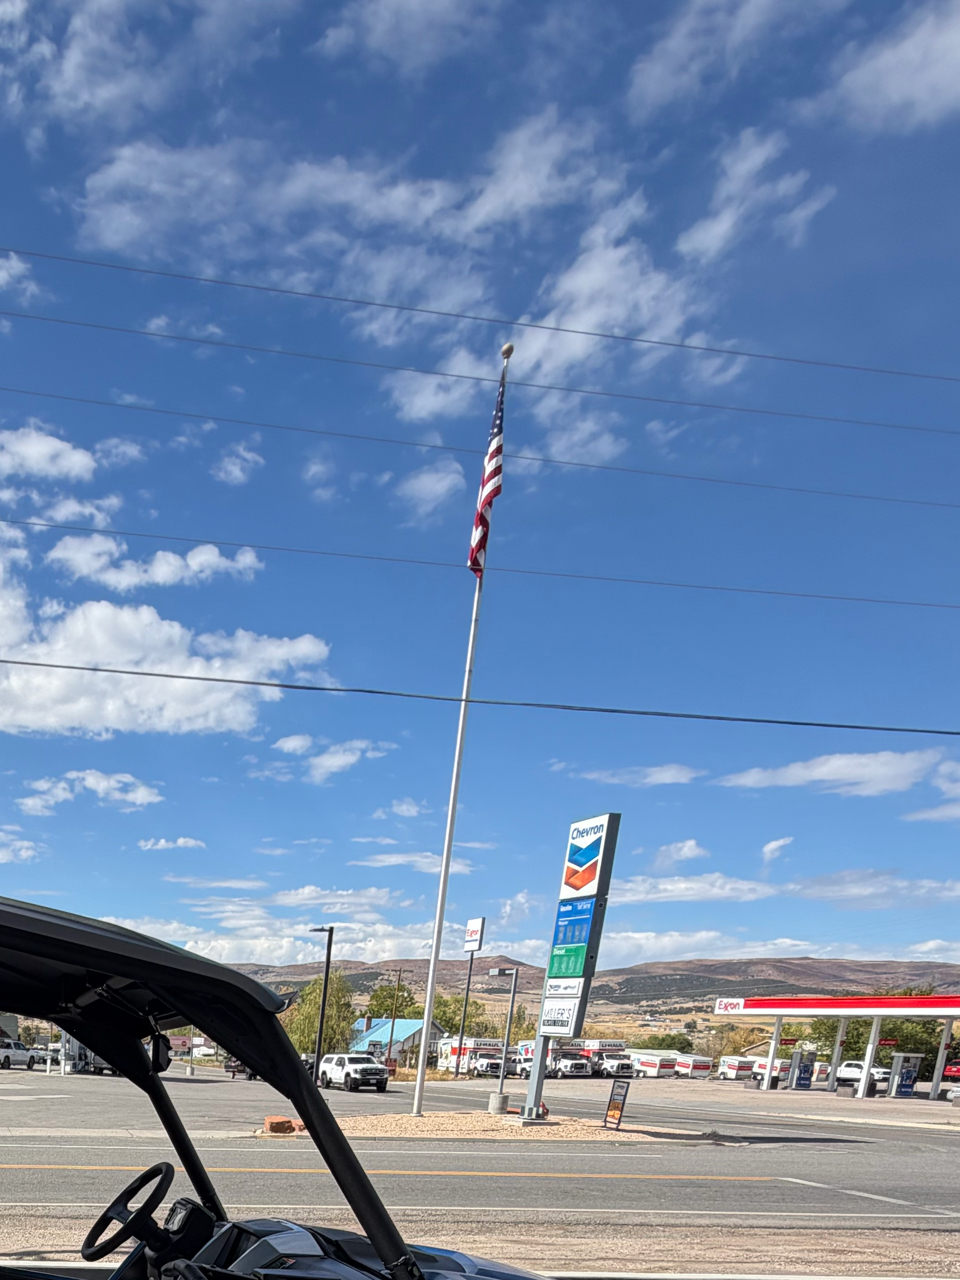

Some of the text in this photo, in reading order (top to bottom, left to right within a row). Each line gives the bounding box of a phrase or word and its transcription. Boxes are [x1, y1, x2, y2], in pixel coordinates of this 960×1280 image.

[571, 823, 605, 840] Chevron
[718, 1000, 740, 1012] Exxon
[543, 1008, 572, 1019] MILLER'S
